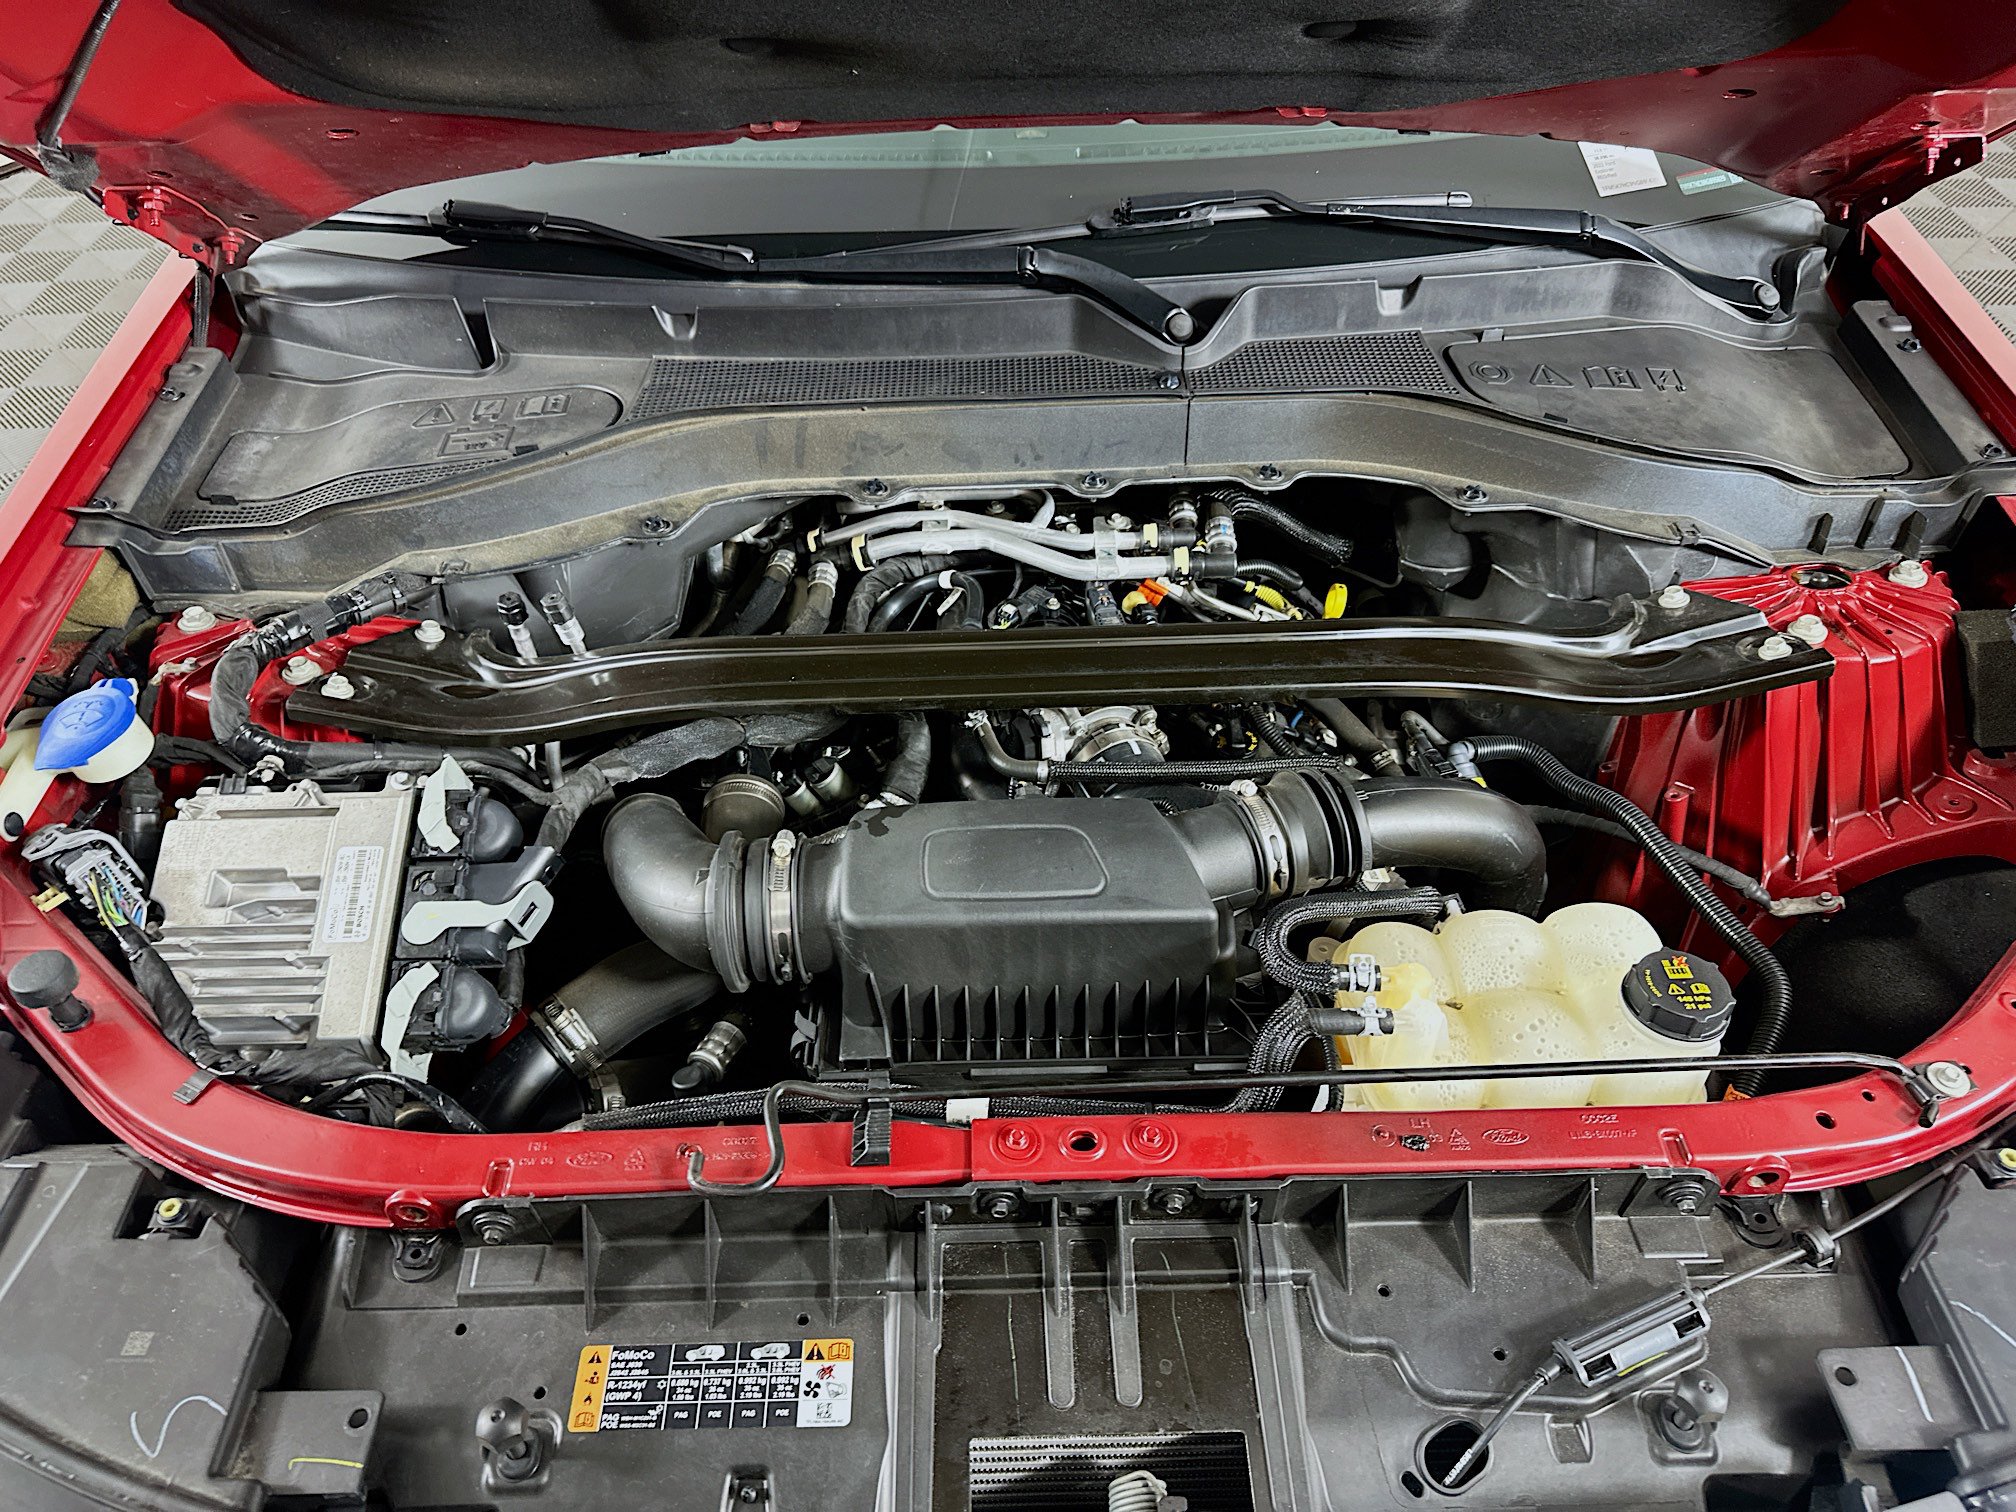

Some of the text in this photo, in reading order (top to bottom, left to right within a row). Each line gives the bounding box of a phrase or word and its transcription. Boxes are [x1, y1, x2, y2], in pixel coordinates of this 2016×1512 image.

[1409, 1117, 1431, 1128] LH
[1487, 1129, 1527, 1145] Ford
[611, 1349, 656, 1361] FoMoCo
[606, 1380, 648, 1391] R-1234yf
[605, 1391, 631, 1402] (GWP
[602, 1413, 620, 1421] PAG
[674, 1411, 689, 1419] PAG
[741, 1409, 756, 1417] PAG
[600, 1421, 619, 1429] POE
